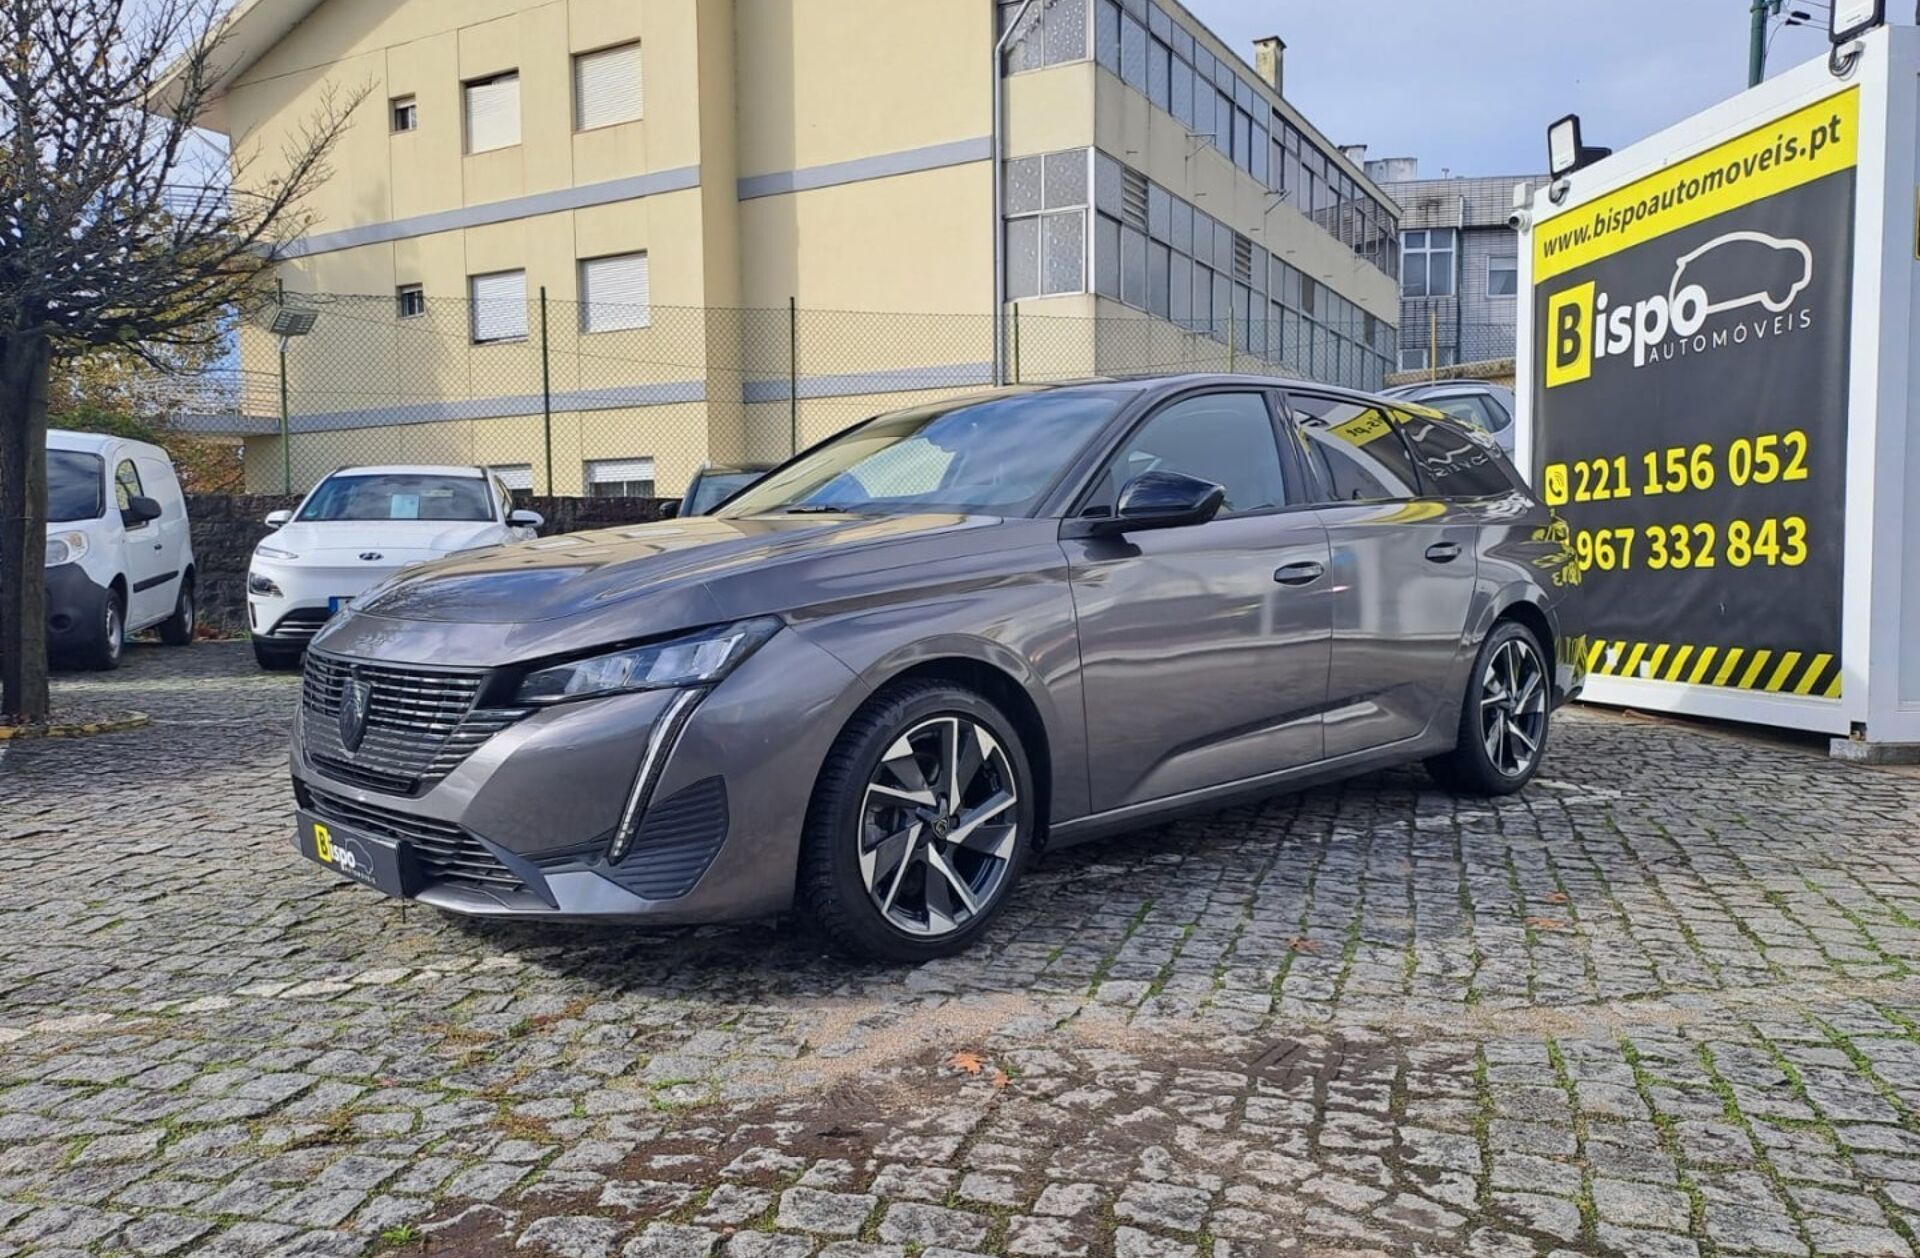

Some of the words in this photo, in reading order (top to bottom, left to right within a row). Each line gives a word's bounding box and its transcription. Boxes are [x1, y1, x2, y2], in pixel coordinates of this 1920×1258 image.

[1543, 114, 1841, 258] www.bispoautomoveis.pt
[1555, 283, 1709, 370] Bispo
[1649, 308, 1812, 363] AUTOMÓVEIS
[1573, 455, 1632, 502] 221
[1642, 443, 1716, 496] 156
[1727, 430, 1809, 487] 052
[1577, 527, 1636, 572] 967
[1646, 522, 1716, 570] 332
[1726, 515, 1808, 569] 843
[317, 828, 356, 871] Bispo
